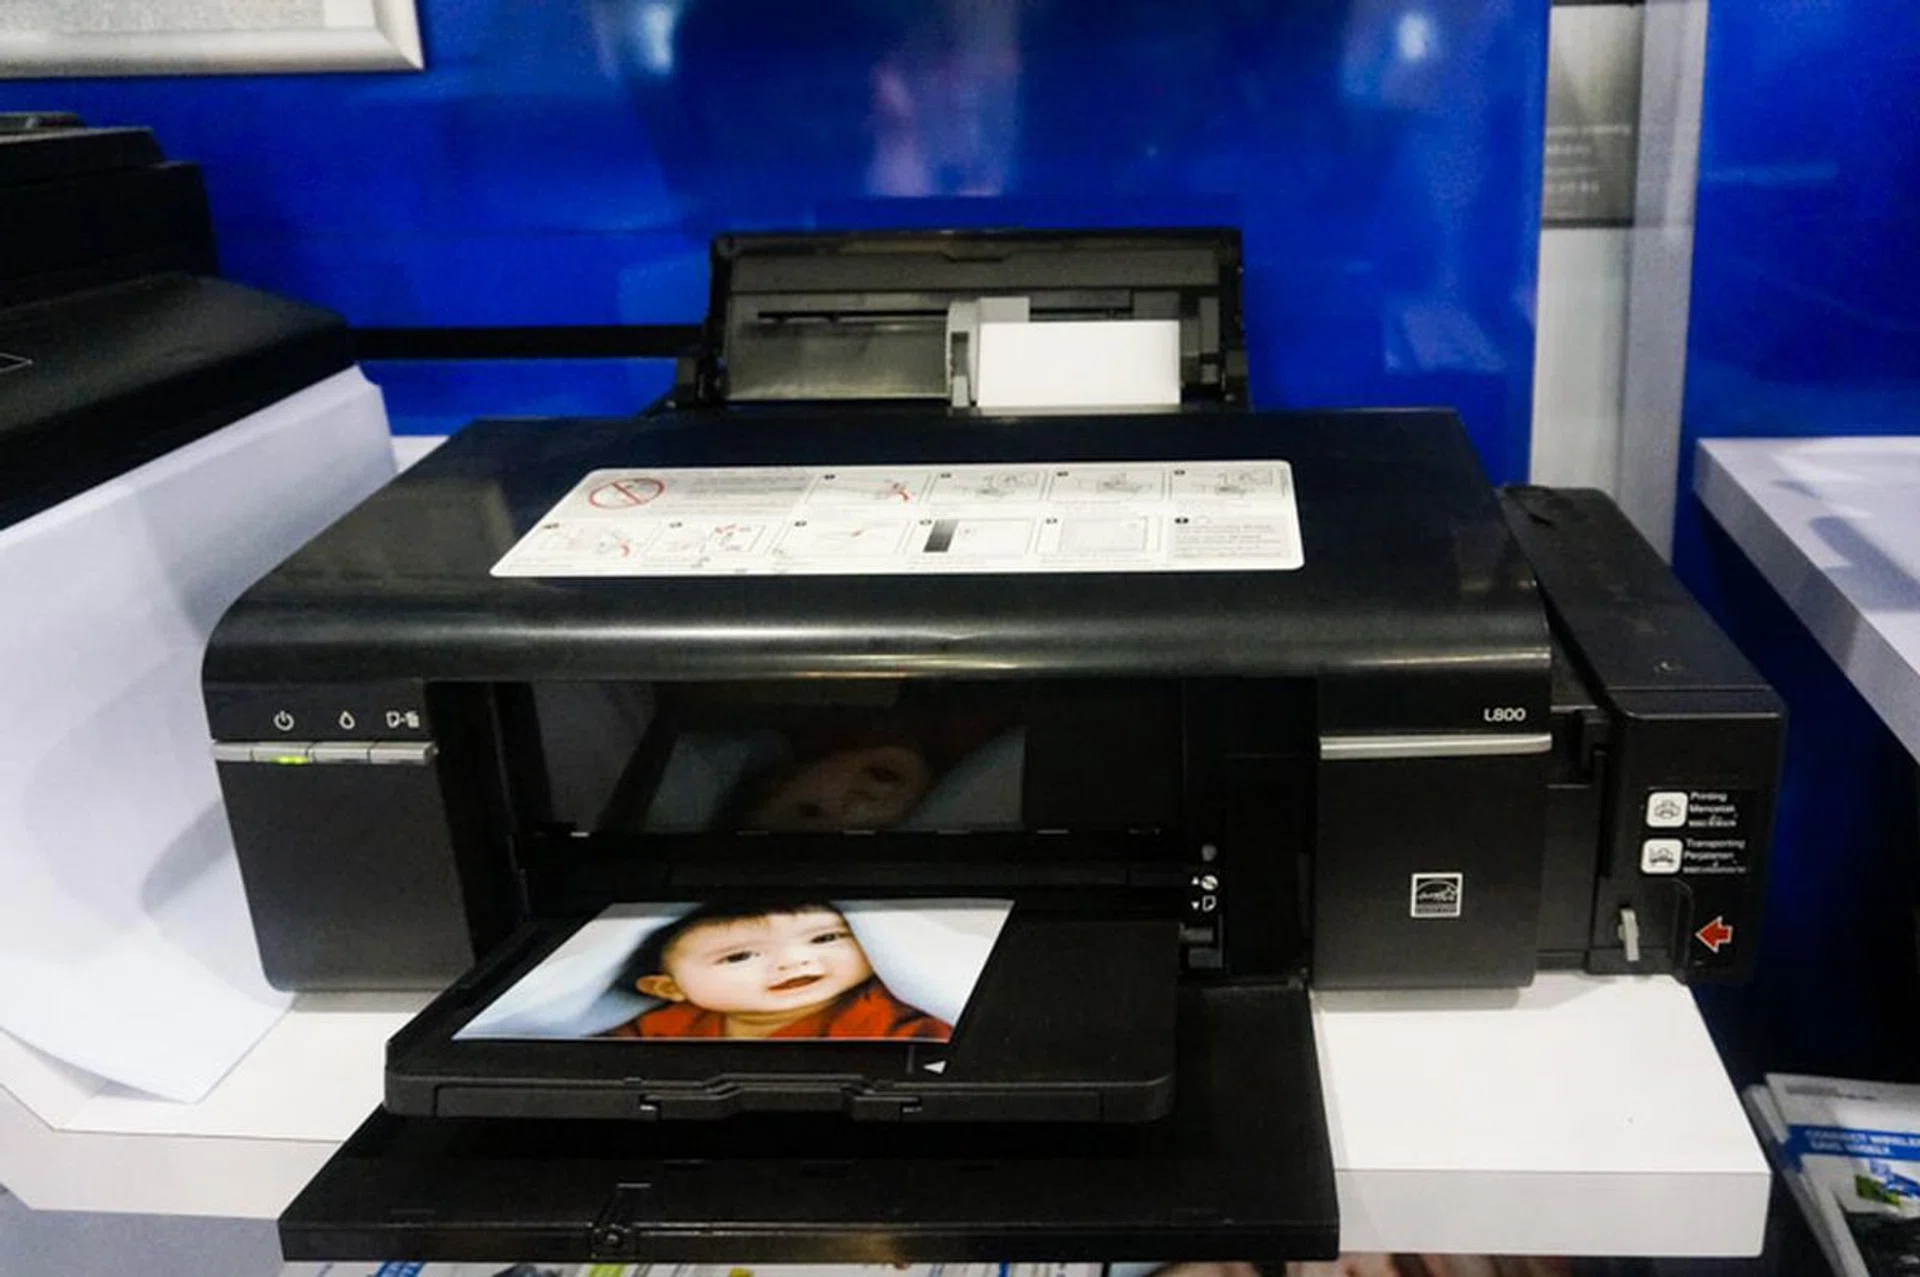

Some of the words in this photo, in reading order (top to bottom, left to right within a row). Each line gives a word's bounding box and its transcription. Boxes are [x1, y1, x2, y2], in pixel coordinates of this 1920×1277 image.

[1484, 707, 1526, 722] L800
[1690, 792, 1727, 803] Printing
[1686, 838, 1746, 849] Transporting
